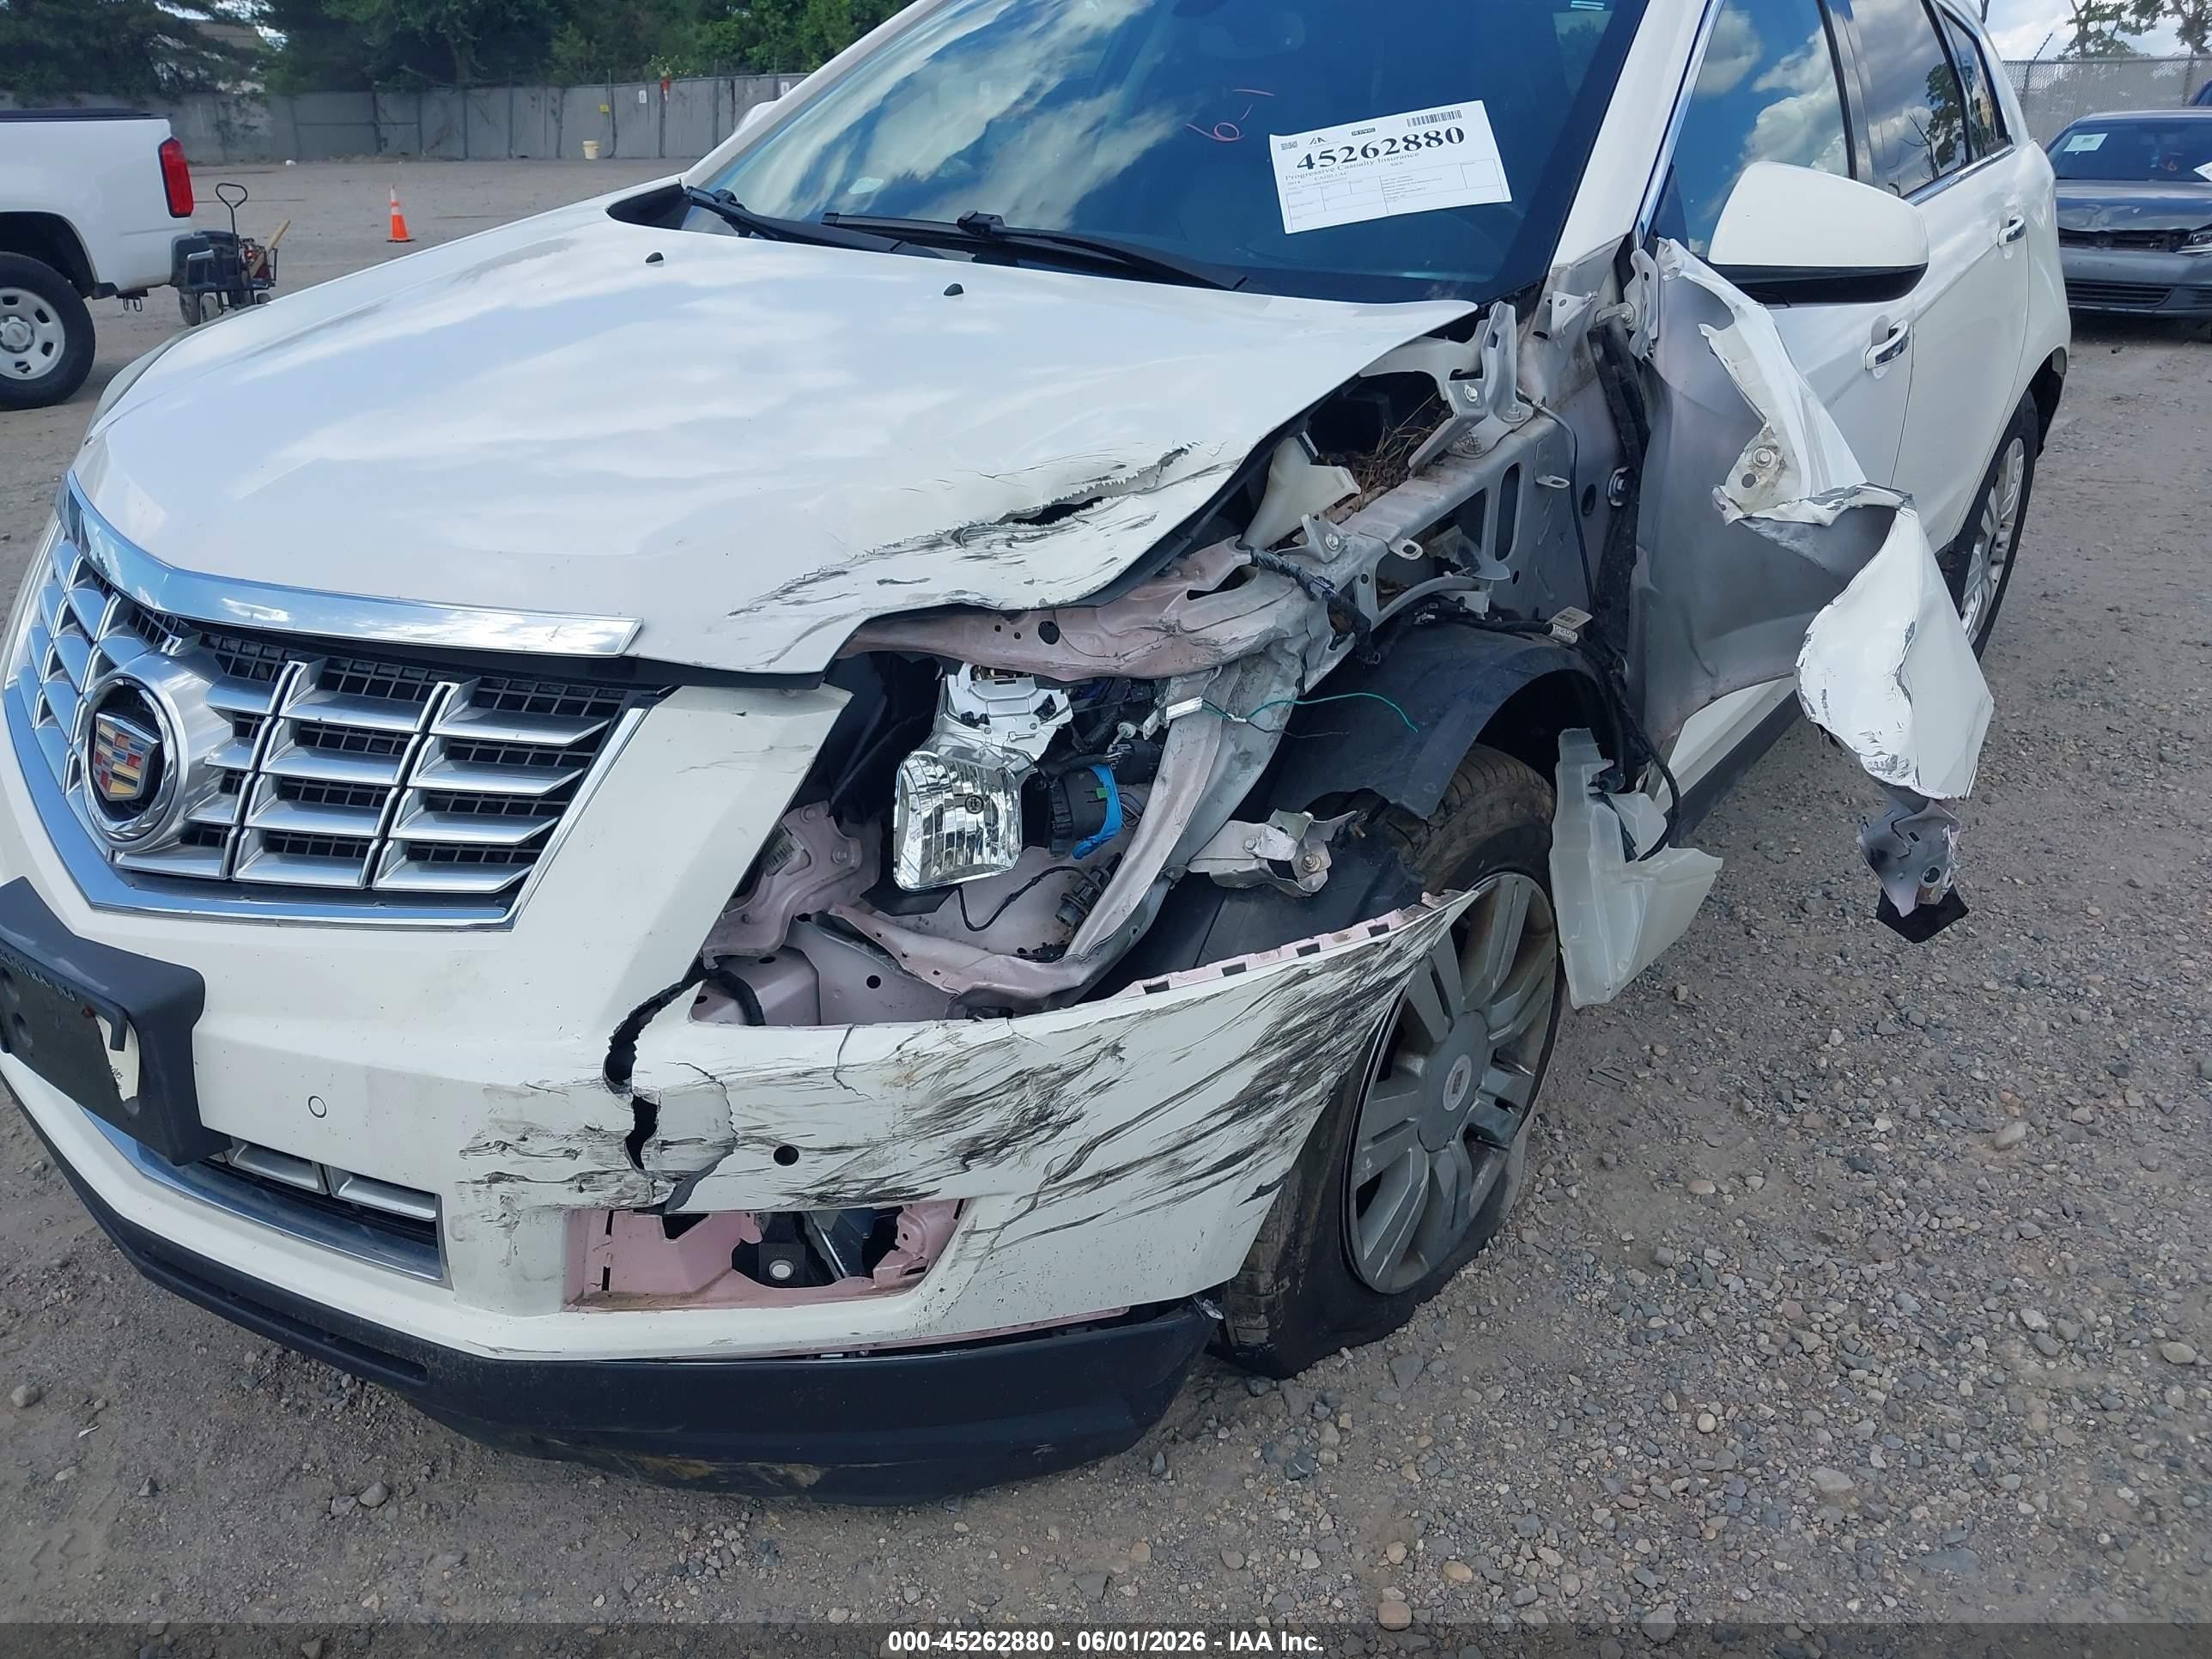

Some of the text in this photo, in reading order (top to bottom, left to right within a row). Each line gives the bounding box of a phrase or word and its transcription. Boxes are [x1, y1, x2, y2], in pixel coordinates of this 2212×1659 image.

[1297, 126, 1465, 170] 45262880
[1285, 166, 1335, 181] Progressive
[1337, 160, 1375, 172] Casualty
[1377, 152, 1419, 164] Insurance
